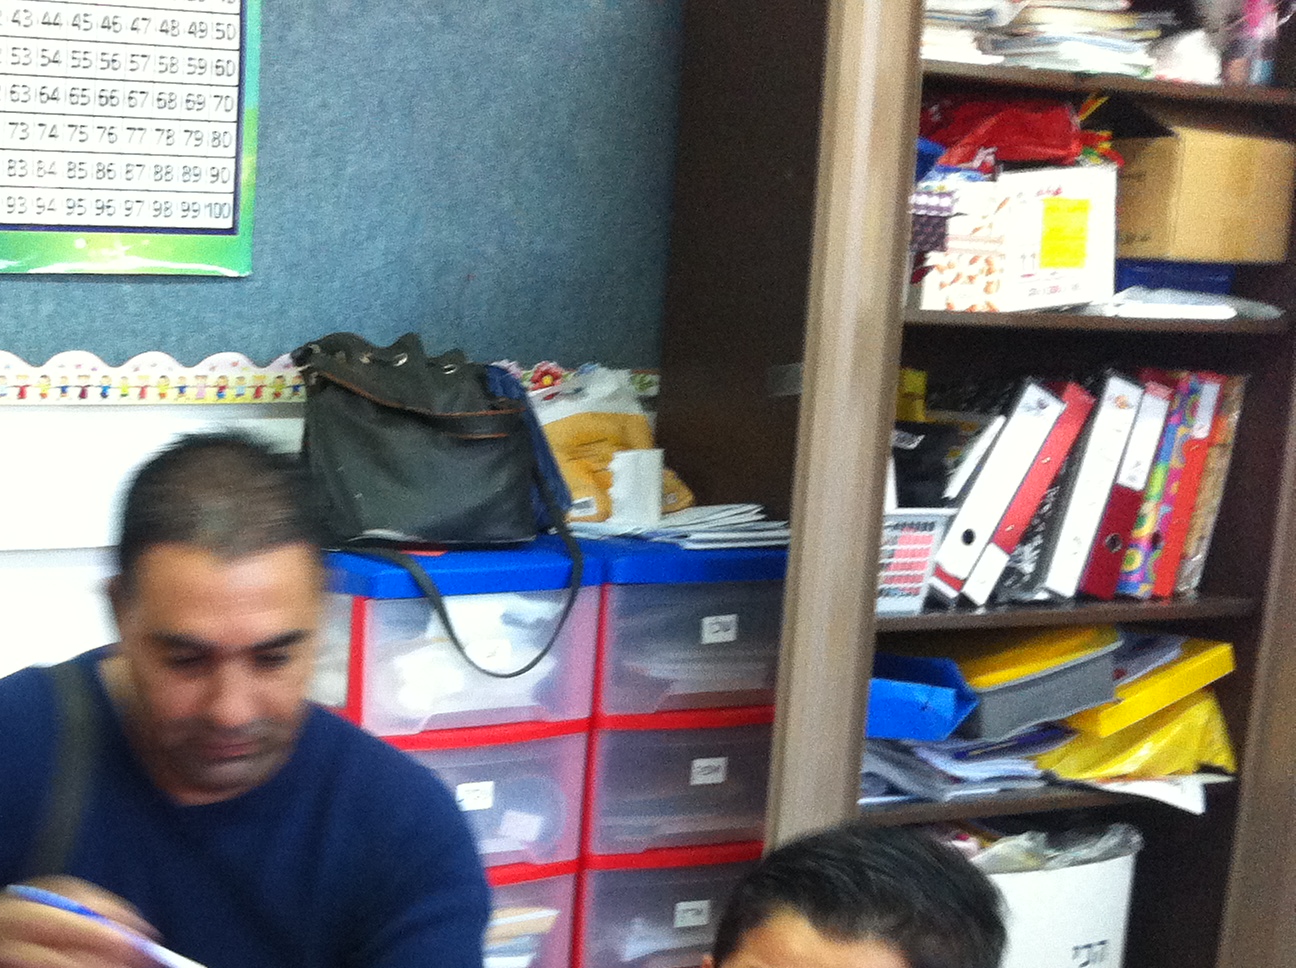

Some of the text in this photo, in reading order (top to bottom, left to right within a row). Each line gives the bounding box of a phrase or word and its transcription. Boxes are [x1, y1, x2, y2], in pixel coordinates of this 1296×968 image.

[11, 9, 35, 30] 43
[40, 11, 63, 32] 44
[70, 13, 94, 33] 45
[100, 15, 123, 35] 46
[130, 16, 152, 36] 47
[159, 18, 181, 38] 48
[188, 20, 209, 39] 49
[215, 22, 237, 41] 50
[10, 46, 34, 67] 53
[39, 48, 63, 69] 54
[70, 49, 93, 70] 55
[99, 51, 122, 71] 56
[128, 53, 151, 73] 57
[158, 54, 180, 74] 58
[187, 56, 208, 76] 59
[214, 58, 236, 77] 60
[9, 84, 32, 104] 63
[38, 85, 62, 106] 64
[69, 87, 92, 107] 65
[98, 88, 121, 108] 66
[127, 90, 149, 109] 67
[156, 91, 178, 111] 68
[185, 93, 206, 112] 69
[213, 94, 235, 113] 70
[8, 122, 31, 141] 73
[37, 123, 60, 142] 74
[67, 124, 90, 143] 75
[96, 125, 119, 144] 76
[125, 126, 148, 145] 77
[154, 127, 176, 146] 78
[183, 128, 204, 147] 79
[211, 129, 233, 148] 80
[7, 159, 29, 179] 83
[36, 160, 58, 180] 84
[66, 161, 88, 180] 85
[95, 162, 117, 181] 86
[124, 163, 146, 182] 87
[153, 164, 174, 183] 88
[181, 165, 202, 183] 89
[209, 166, 231, 184] 90
[6, 196, 28, 215] 93
[35, 197, 58, 216] 94
[65, 198, 87, 217] 95
[94, 198, 117, 217] 96
[124, 199, 146, 218] 97
[152, 200, 173, 219] 98
[180, 201, 201, 219] 99
[206, 202, 232, 220] 100
